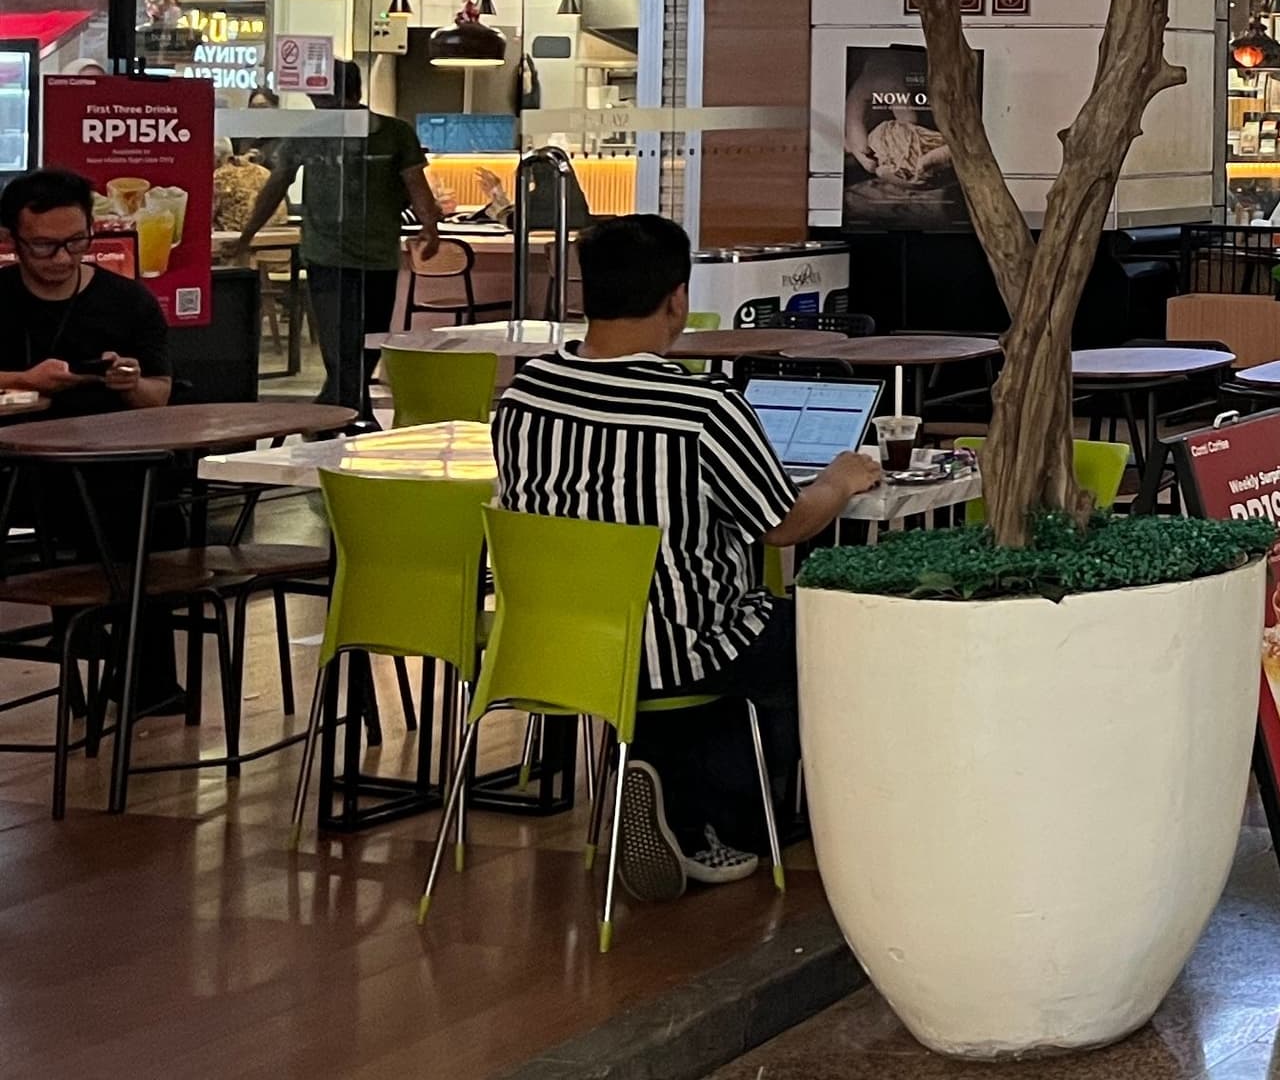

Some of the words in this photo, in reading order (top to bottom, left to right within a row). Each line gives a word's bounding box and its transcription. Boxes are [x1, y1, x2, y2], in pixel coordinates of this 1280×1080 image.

[871, 92, 911, 105] NOW
[86, 105, 111, 114] First
[112, 105, 142, 114] Three
[145, 105, 178, 114] Drinks
[82, 118, 179, 143] RP15K
[1228, 474, 1259, 494] Weekly
